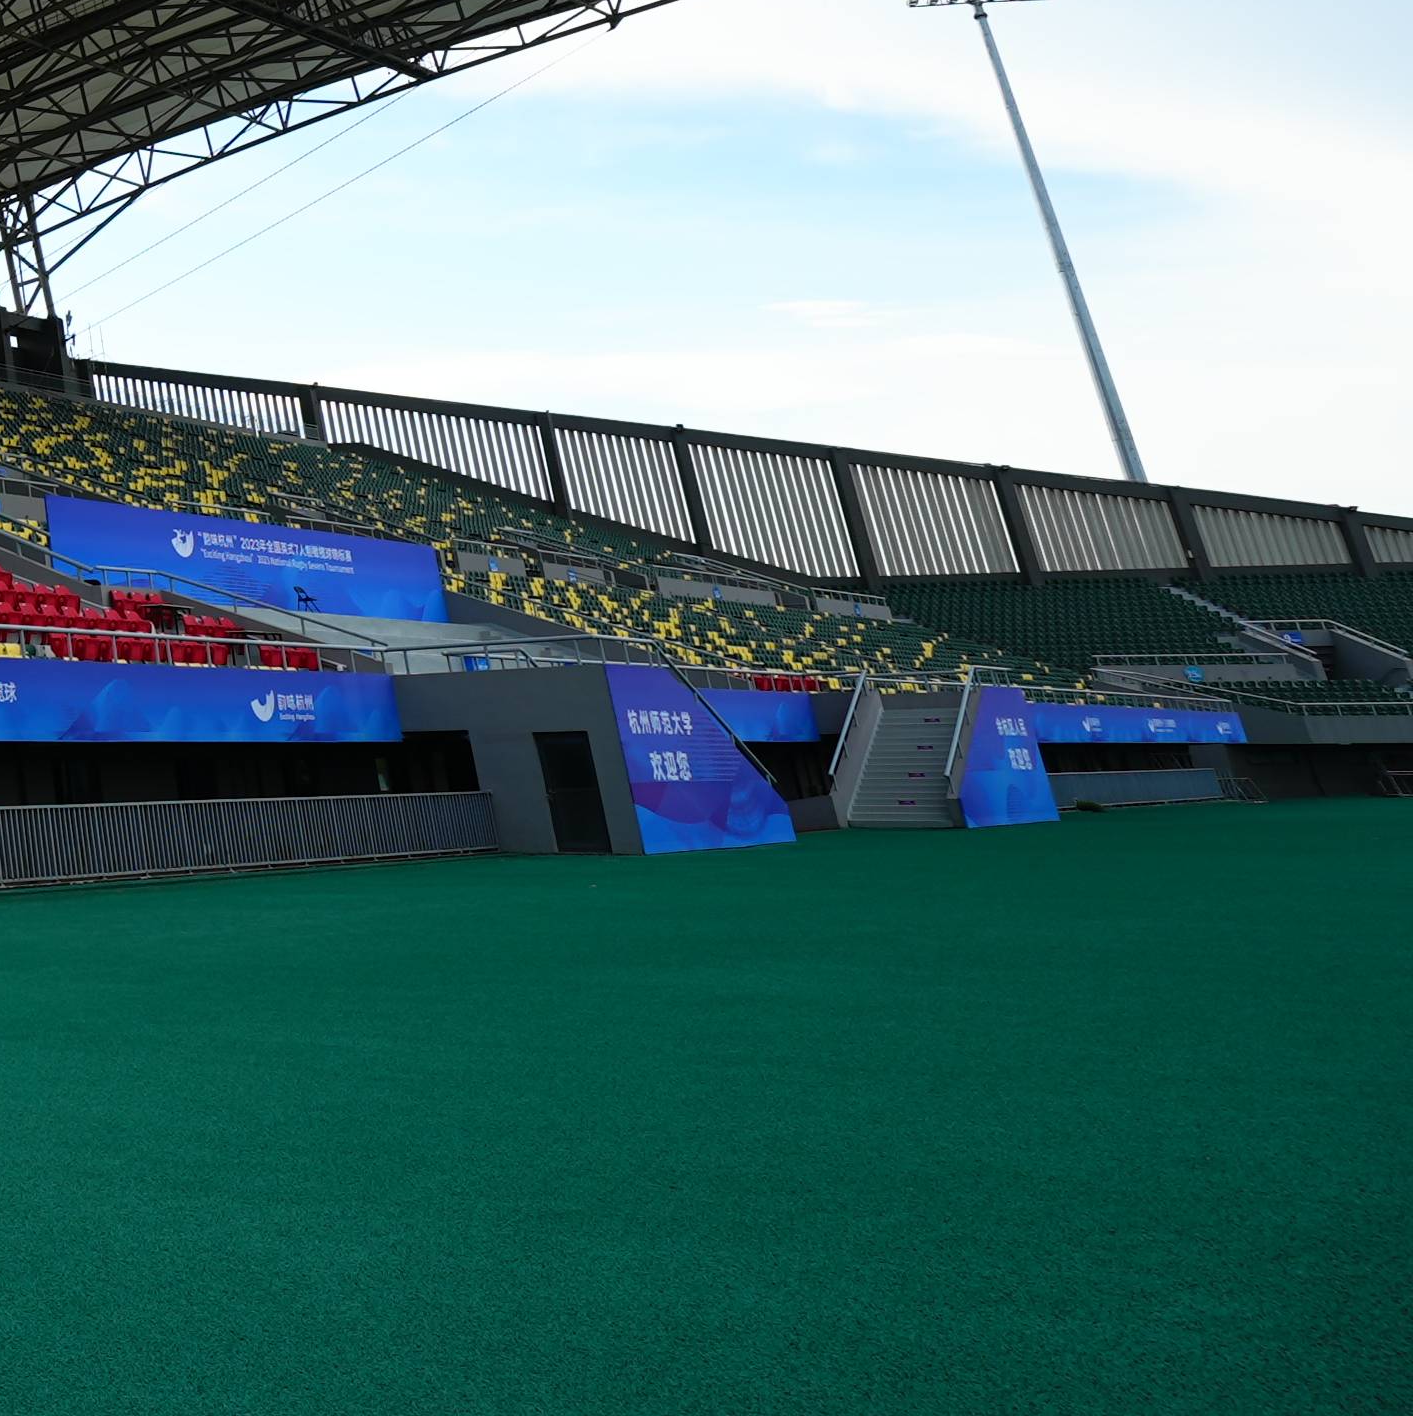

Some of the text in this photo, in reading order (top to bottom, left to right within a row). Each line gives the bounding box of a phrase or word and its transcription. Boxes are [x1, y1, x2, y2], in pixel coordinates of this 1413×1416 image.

[627, 709, 693, 735] 杭州师范大学
[649, 750, 692, 781] 欢迎您
